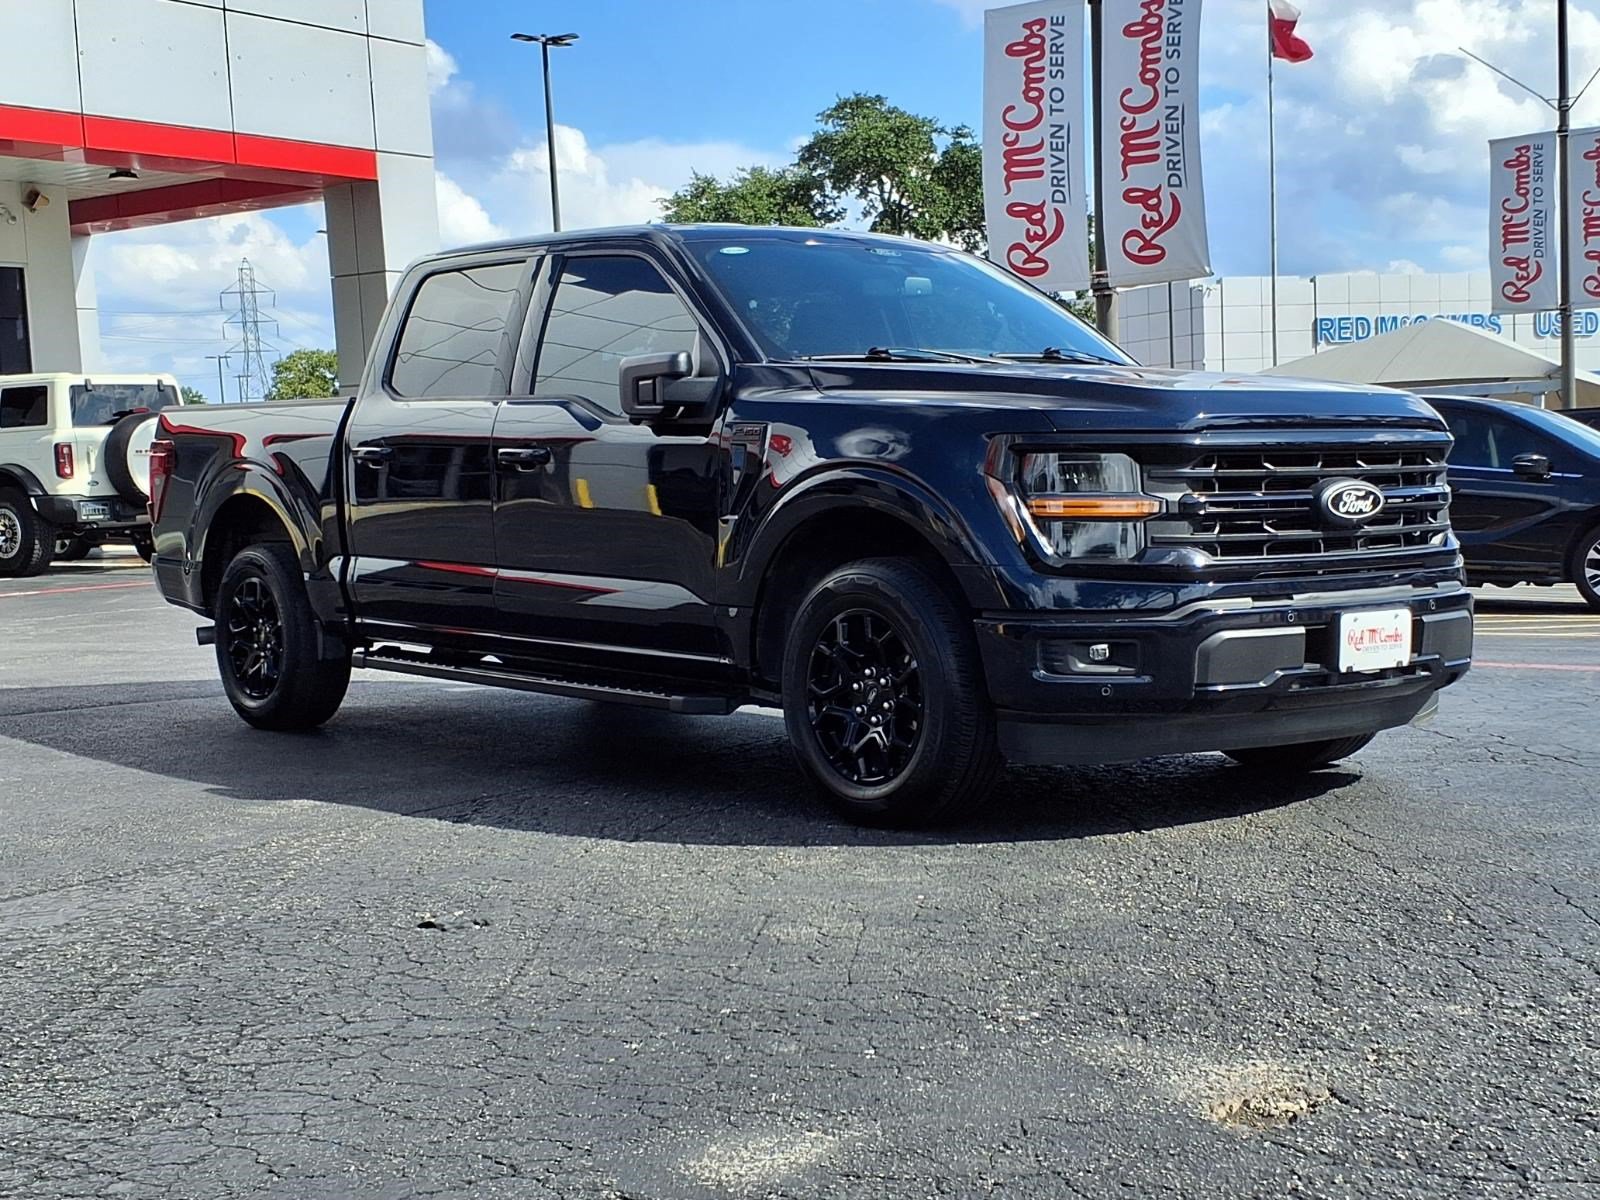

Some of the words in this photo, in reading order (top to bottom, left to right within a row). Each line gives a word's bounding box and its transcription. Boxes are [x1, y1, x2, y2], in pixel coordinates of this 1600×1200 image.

[1050, 15, 1066, 80] SERVE
[1002, 17, 1047, 196] McCombs
[1050, 86, 1065, 116] TO
[1165, 67, 1180, 98] TO
[1050, 123, 1067, 204] DRIVEN
[1165, 105, 1183, 188] DRIVEN
[1533, 143, 1544, 183] SERVE
[1501, 144, 1531, 253] McCombs
[1533, 187, 1544, 206] TO
[1006, 200, 1065, 277] Red
[1121, 184, 1182, 265] Red
[1533, 209, 1545, 259] DRIVEN
[1502, 256, 1543, 303] Red
[1318, 316, 1371, 342] RED
[1338, 489, 1374, 513] Ford
[1347, 628, 1365, 651] Red
